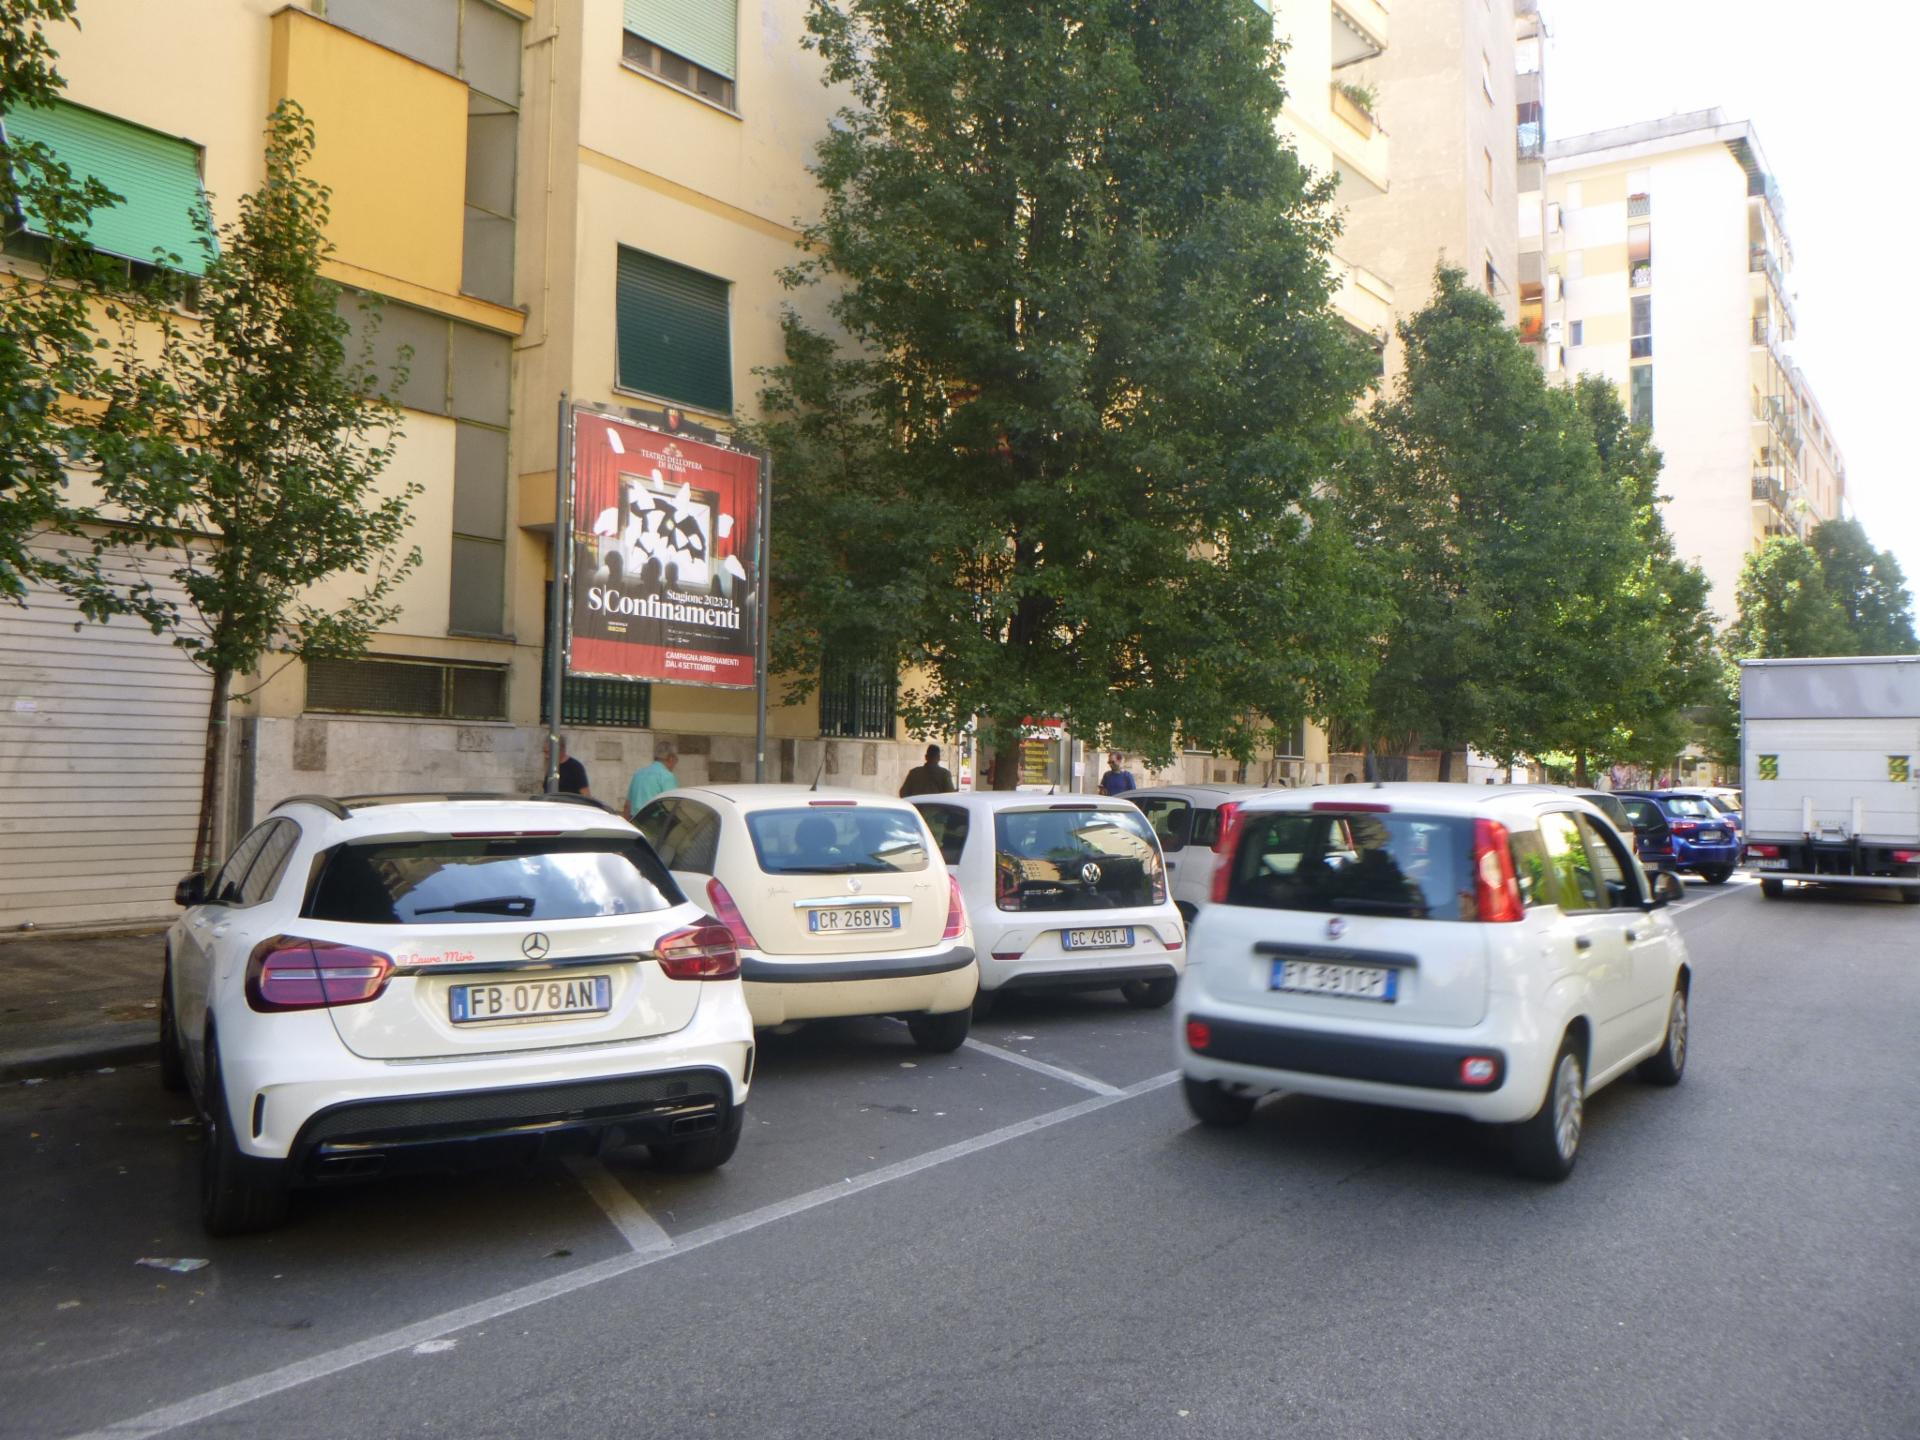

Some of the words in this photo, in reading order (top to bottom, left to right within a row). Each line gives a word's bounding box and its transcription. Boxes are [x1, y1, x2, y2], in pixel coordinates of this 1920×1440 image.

[641, 449, 667, 461] TEATRO
[658, 460, 667, 469] DI
[667, 461, 687, 473] ROMA
[666, 589, 703, 605] Stagione
[665, 651, 698, 662] CAMPAGNA
[699, 655, 740, 666] ABBONAMENTI
[665, 660, 677, 669] DAL
[683, 662, 717, 672] SETTEMBRE
[819, 912, 838, 929] CR
[844, 910, 891, 928] 268VS
[1071, 931, 1086, 946] GC
[1091, 929, 1126, 944] 498TJ
[471, 988, 503, 1016] FB
[514, 981, 593, 1012] 078AN
